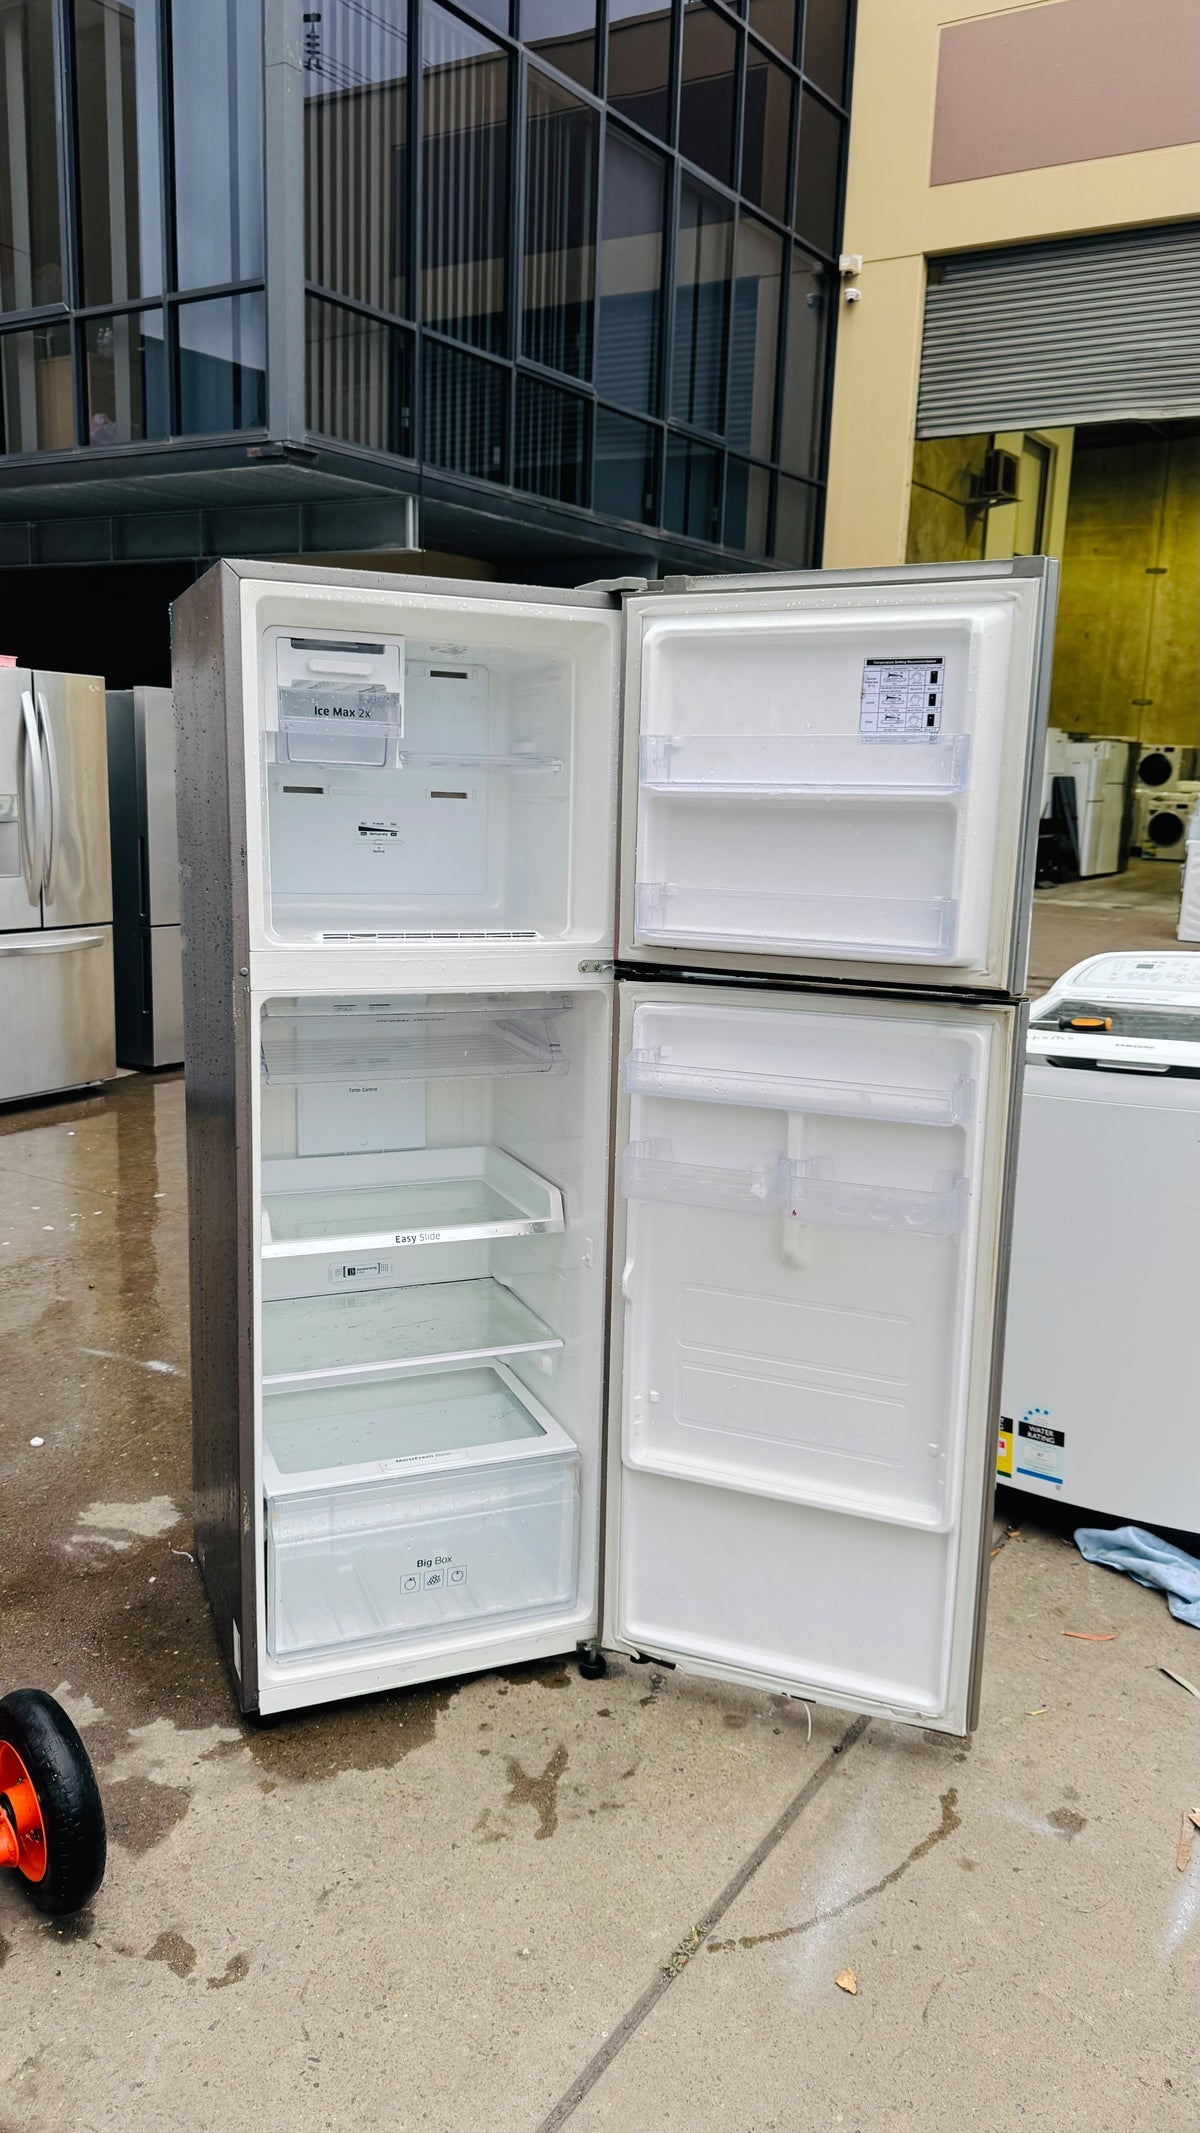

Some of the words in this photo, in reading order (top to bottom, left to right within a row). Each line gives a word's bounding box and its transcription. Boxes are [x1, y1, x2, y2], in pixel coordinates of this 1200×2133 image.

[314, 706, 330, 716] Ice
[333, 707, 356, 718] Max
[358, 708, 371, 719] 2x
[395, 1235, 417, 1244] Easy
[419, 1232, 441, 1241] Slide
[1028, 1426, 1054, 1436] WATER
[1027, 1432, 1055, 1443] RATING
[416, 1558, 433, 1568] Big
[434, 1556, 453, 1565] Box
